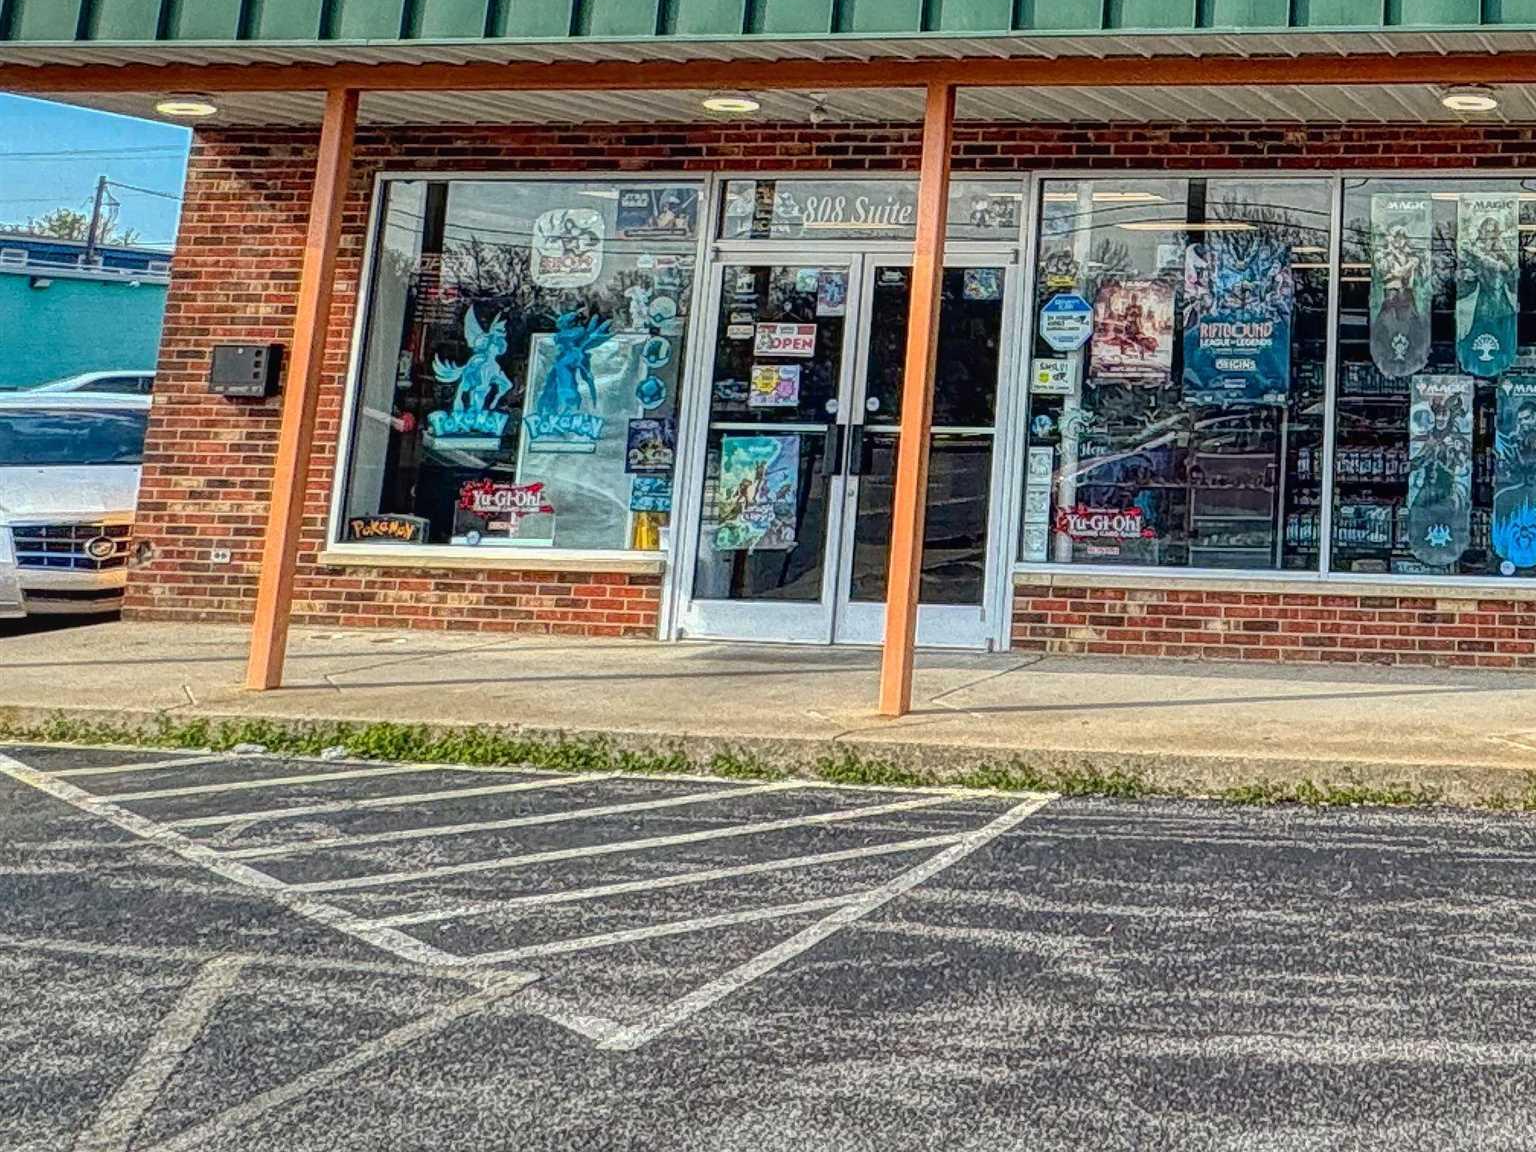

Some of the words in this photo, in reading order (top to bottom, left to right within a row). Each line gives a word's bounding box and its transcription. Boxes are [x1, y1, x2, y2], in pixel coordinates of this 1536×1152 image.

[802, 196, 846, 224] 808
[850, 195, 913, 224] Suite
[1473, 200, 1514, 210] MAGIC
[771, 337, 813, 350] OPEN
